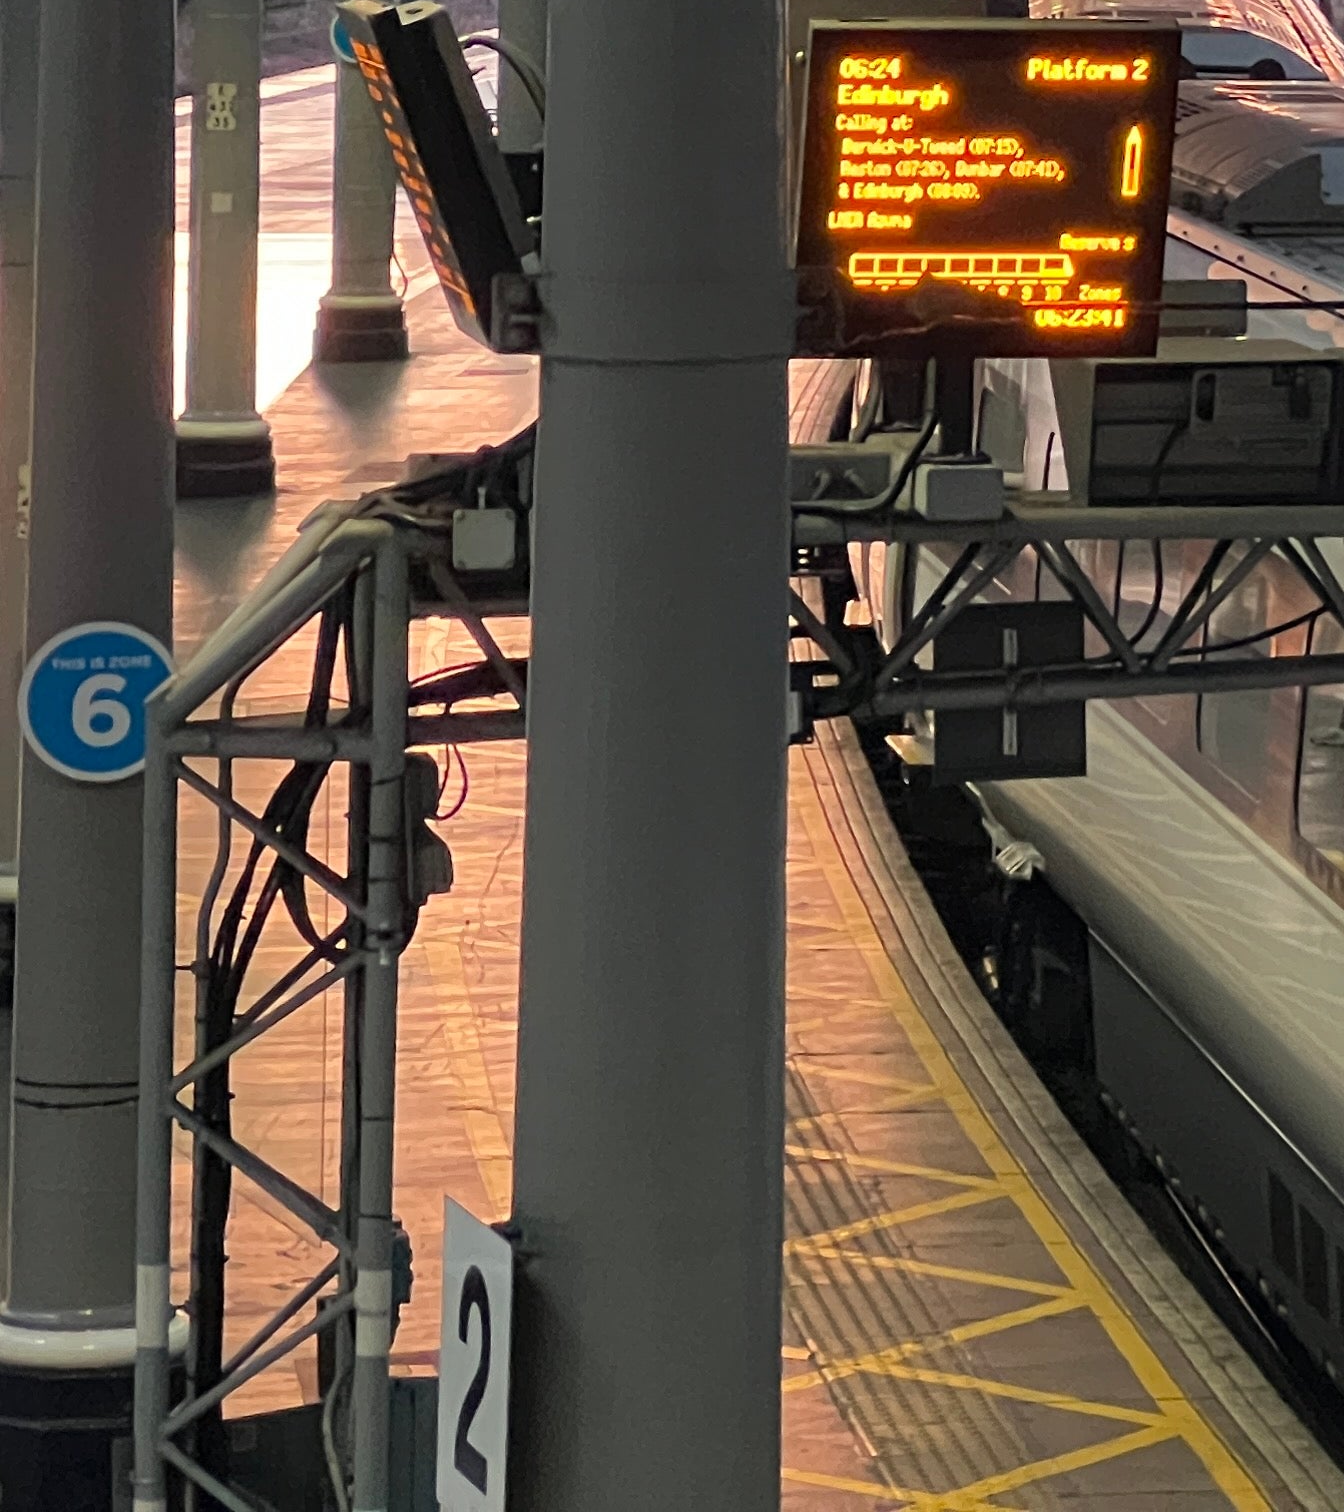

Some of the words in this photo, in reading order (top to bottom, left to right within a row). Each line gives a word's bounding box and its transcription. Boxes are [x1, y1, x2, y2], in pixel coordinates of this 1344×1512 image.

[839, 57, 901, 79] 06:24
[1026, 57, 1128, 80] Platform
[1131, 58, 1149, 80] 2
[837, 83, 949, 111] Edinburgh
[836, 113, 888, 134] Calling
[891, 114, 914, 131] at:
[853, 182, 924, 203] Edinburgh
[51, 655, 87, 670] THIS
[90, 656, 105, 670] IS
[108, 654, 153, 670] ZONE
[72, 673, 131, 748] 6
[454, 1263, 492, 1497] 2
